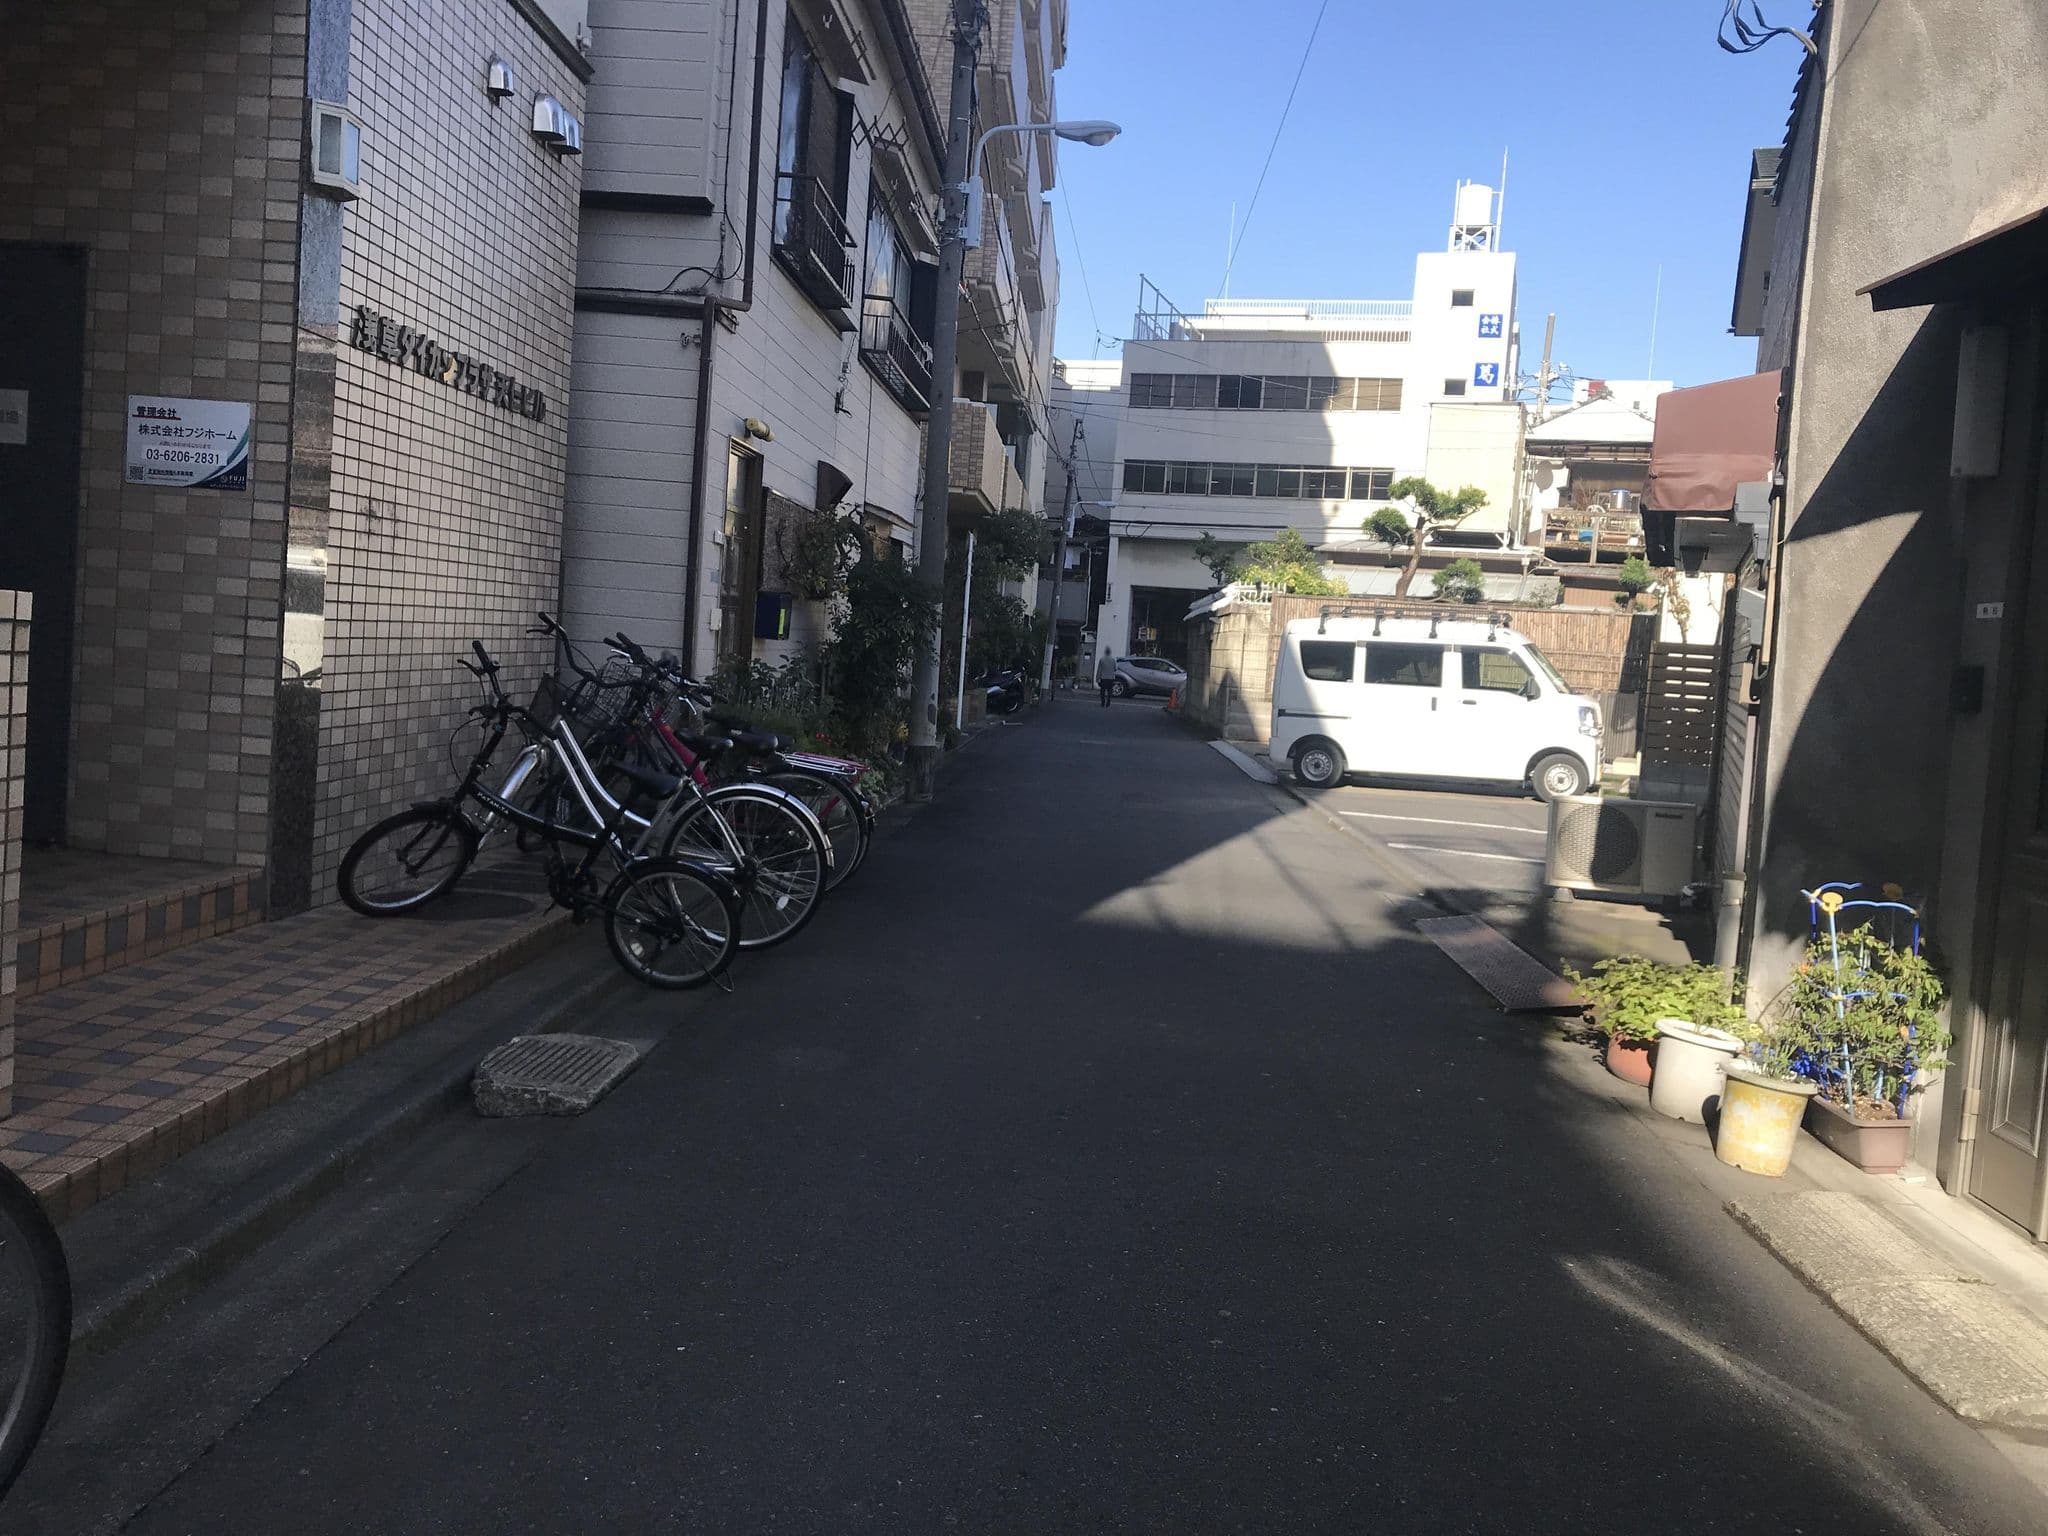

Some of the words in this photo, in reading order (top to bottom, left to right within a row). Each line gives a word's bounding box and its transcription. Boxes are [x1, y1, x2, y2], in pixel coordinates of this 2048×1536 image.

[136, 405, 177, 418] 管理会社
[138, 423, 237, 441] 株式会社フジホーム
[146, 448, 220, 465] 03-6206-2831
